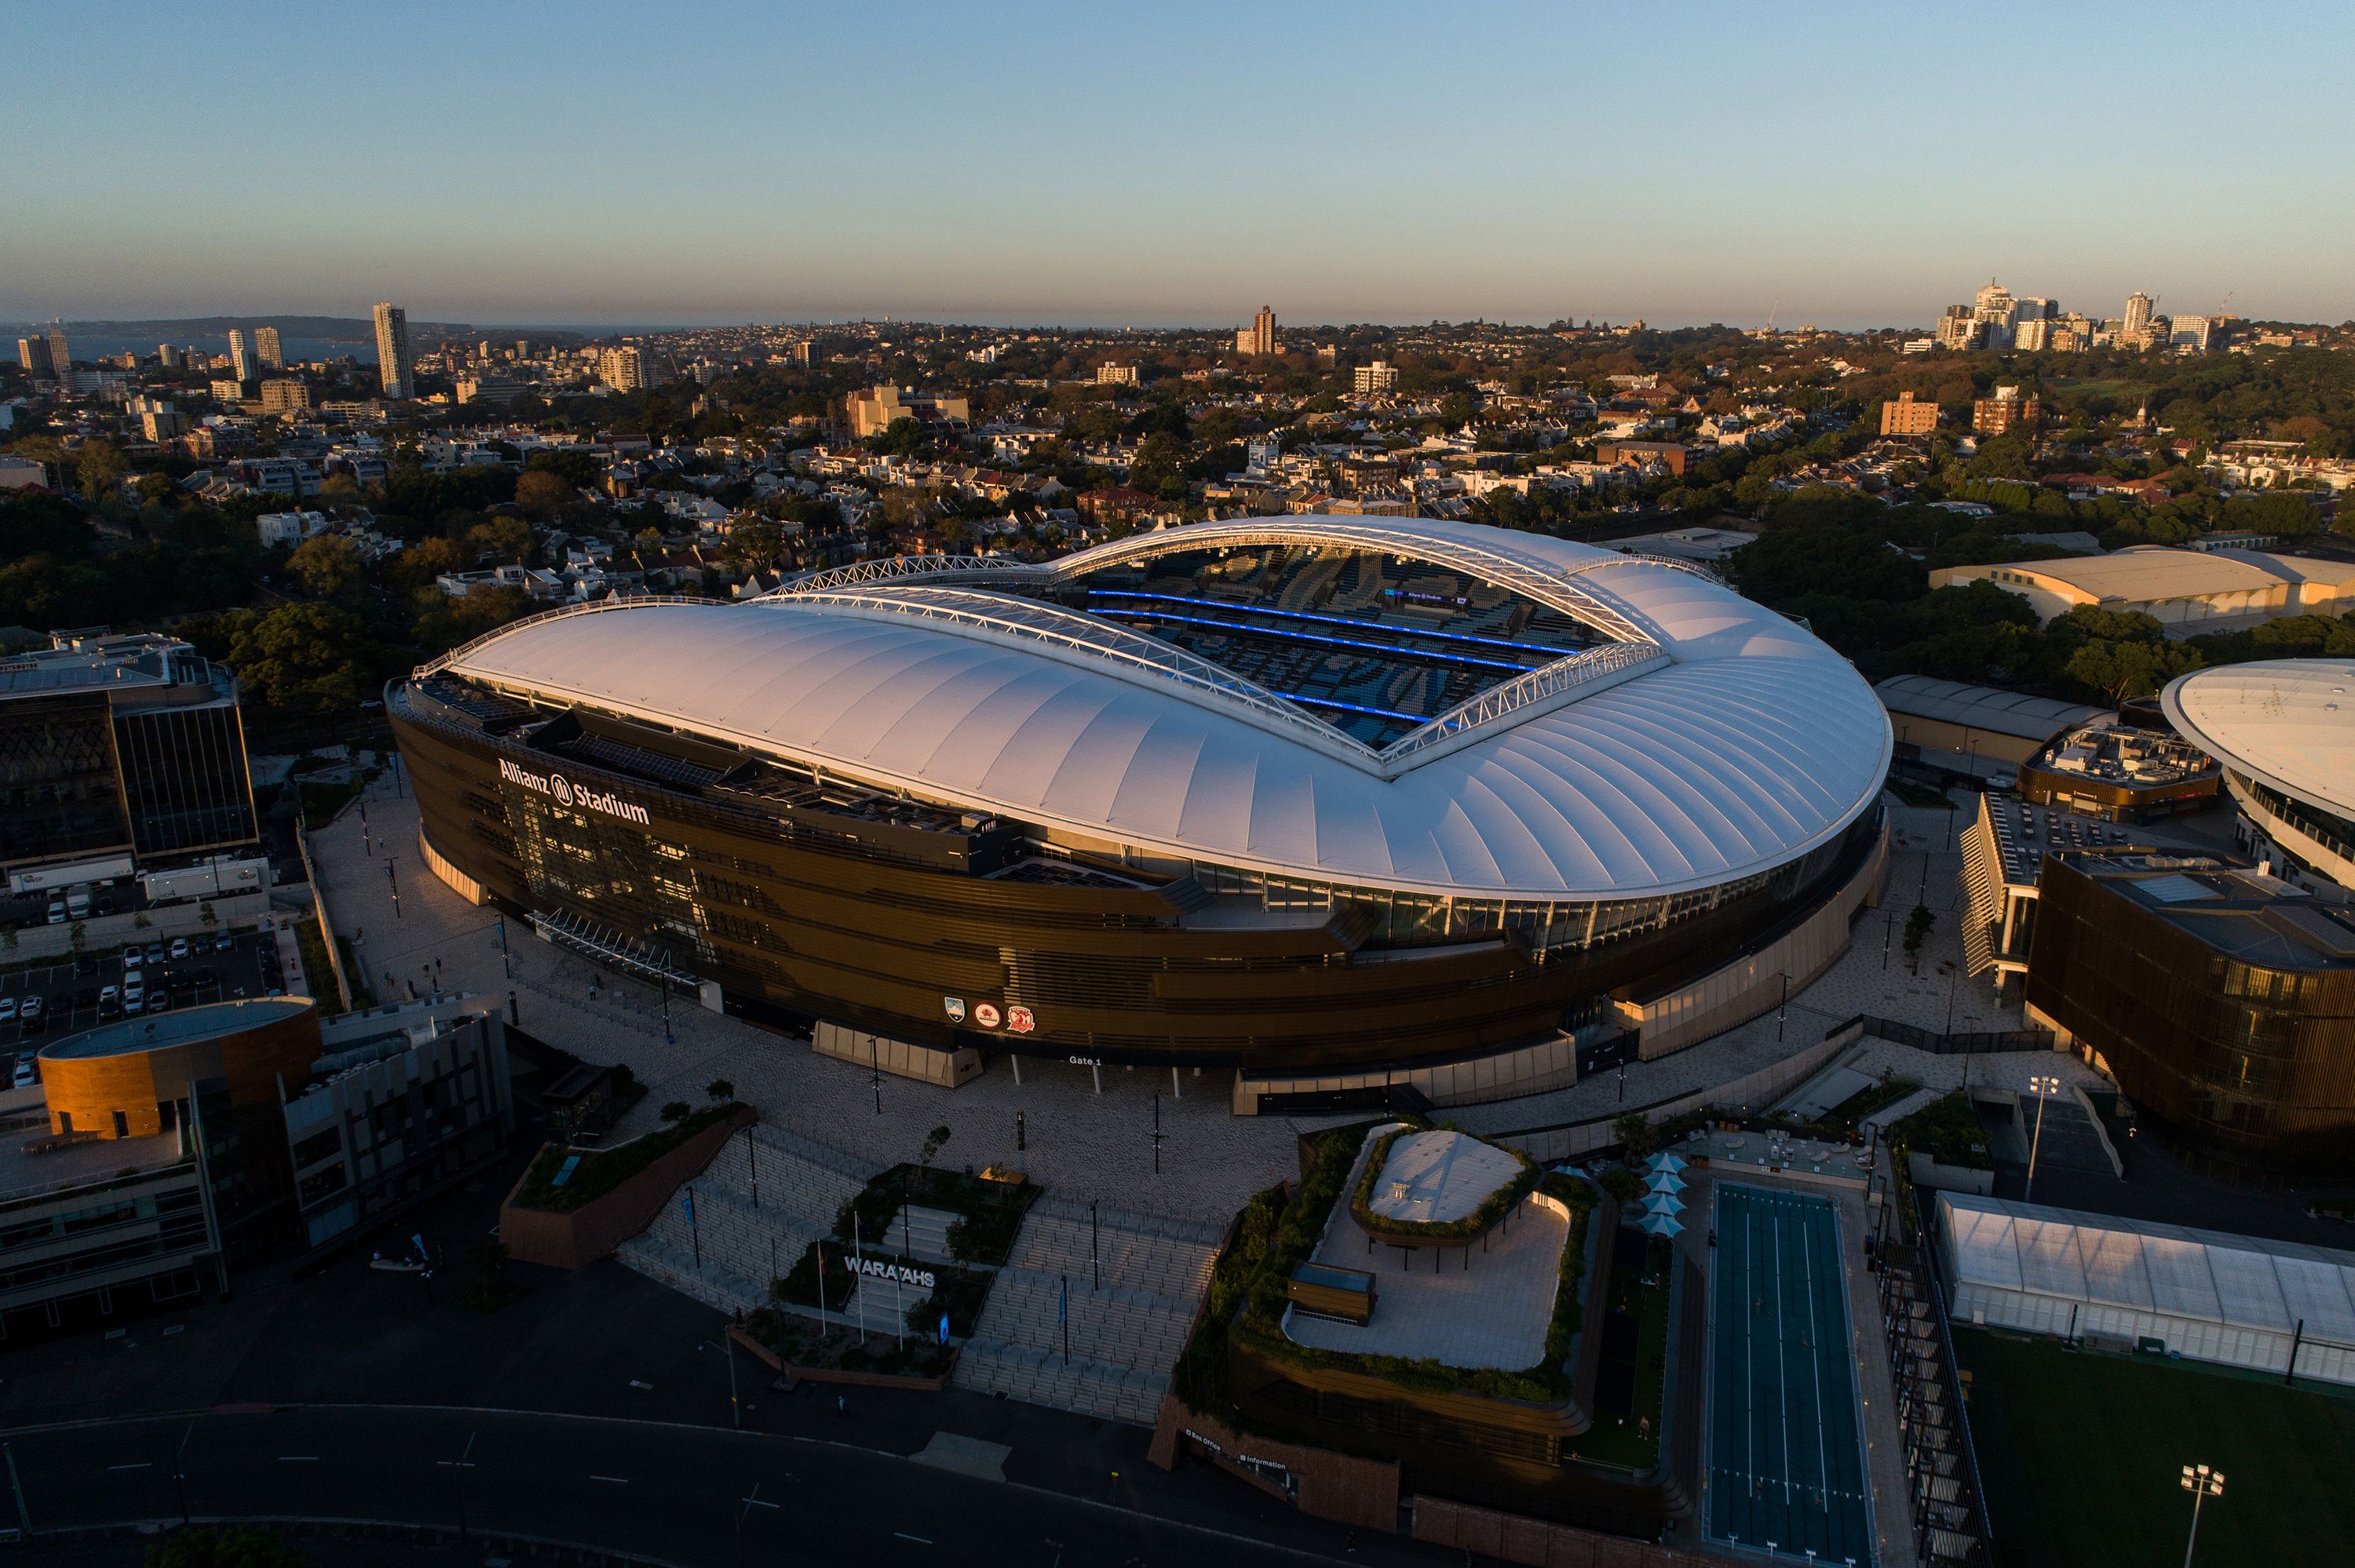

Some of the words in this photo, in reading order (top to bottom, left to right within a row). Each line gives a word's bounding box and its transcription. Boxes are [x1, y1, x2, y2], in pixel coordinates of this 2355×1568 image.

[498, 758, 551, 795] Allianz
[574, 783, 650, 825] Stadium
[1069, 1056, 1093, 1066] Gate
[844, 1256, 936, 1288] WARATAHS
[1192, 1431, 1203, 1442] Box
[1203, 1438, 1221, 1451] Office
[1247, 1456, 1286, 1470] Information
